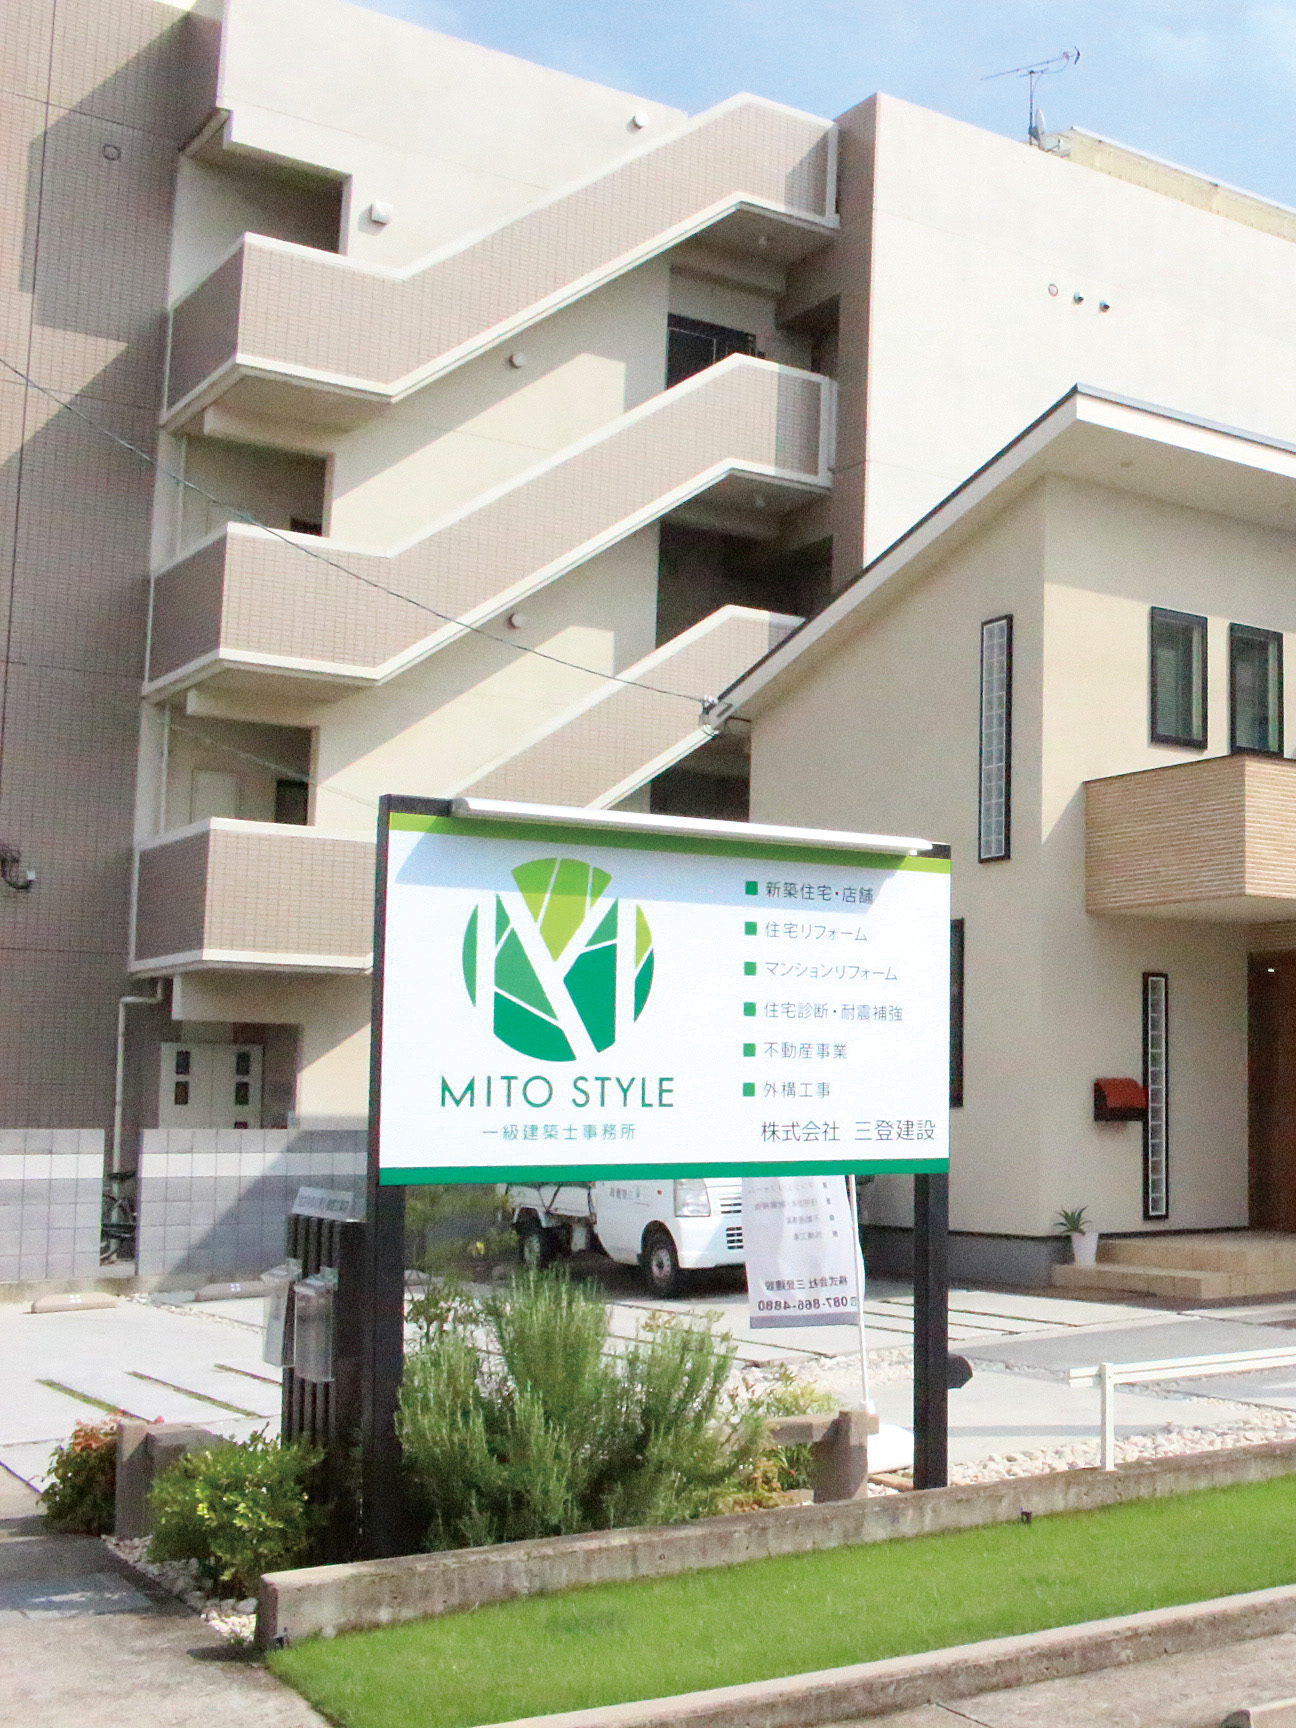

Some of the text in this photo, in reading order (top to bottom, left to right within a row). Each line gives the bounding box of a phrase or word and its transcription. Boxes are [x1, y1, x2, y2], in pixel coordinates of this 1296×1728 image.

[765, 881, 874, 904] 新築住宅・店舗
[765, 921, 868, 942] 住宅リフォーム
[764, 962, 897, 981] マンションリフォーム
[764, 1002, 903, 1022] 住宅診断・耐震補強
[764, 1042, 848, 1059] 不動産事業
[440, 1075, 674, 1108] MITO STYLE
[764, 1081, 830, 1099] 外構工事
[482, 1123, 637, 1141] 一級建築士事務所
[761, 1120, 936, 1142] 株式会社 三登建設
